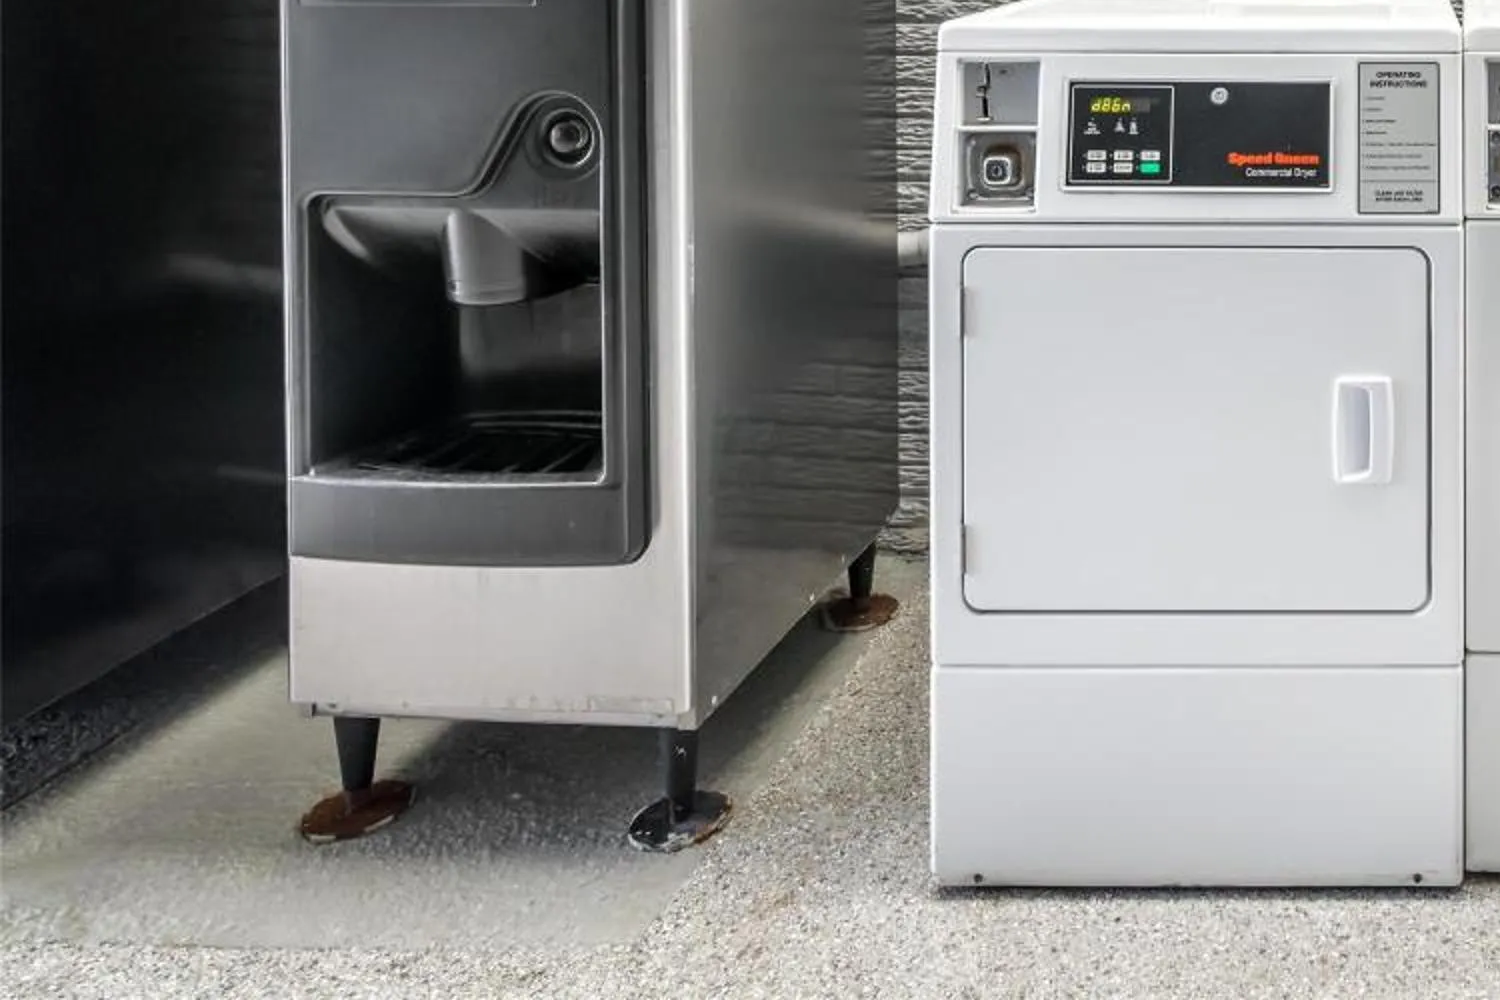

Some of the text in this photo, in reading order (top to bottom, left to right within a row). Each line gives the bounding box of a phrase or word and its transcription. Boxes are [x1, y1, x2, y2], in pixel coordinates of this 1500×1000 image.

[1227, 152, 1319, 167] Speed Queen
[1245, 168, 1317, 179] Commercial Dryer
